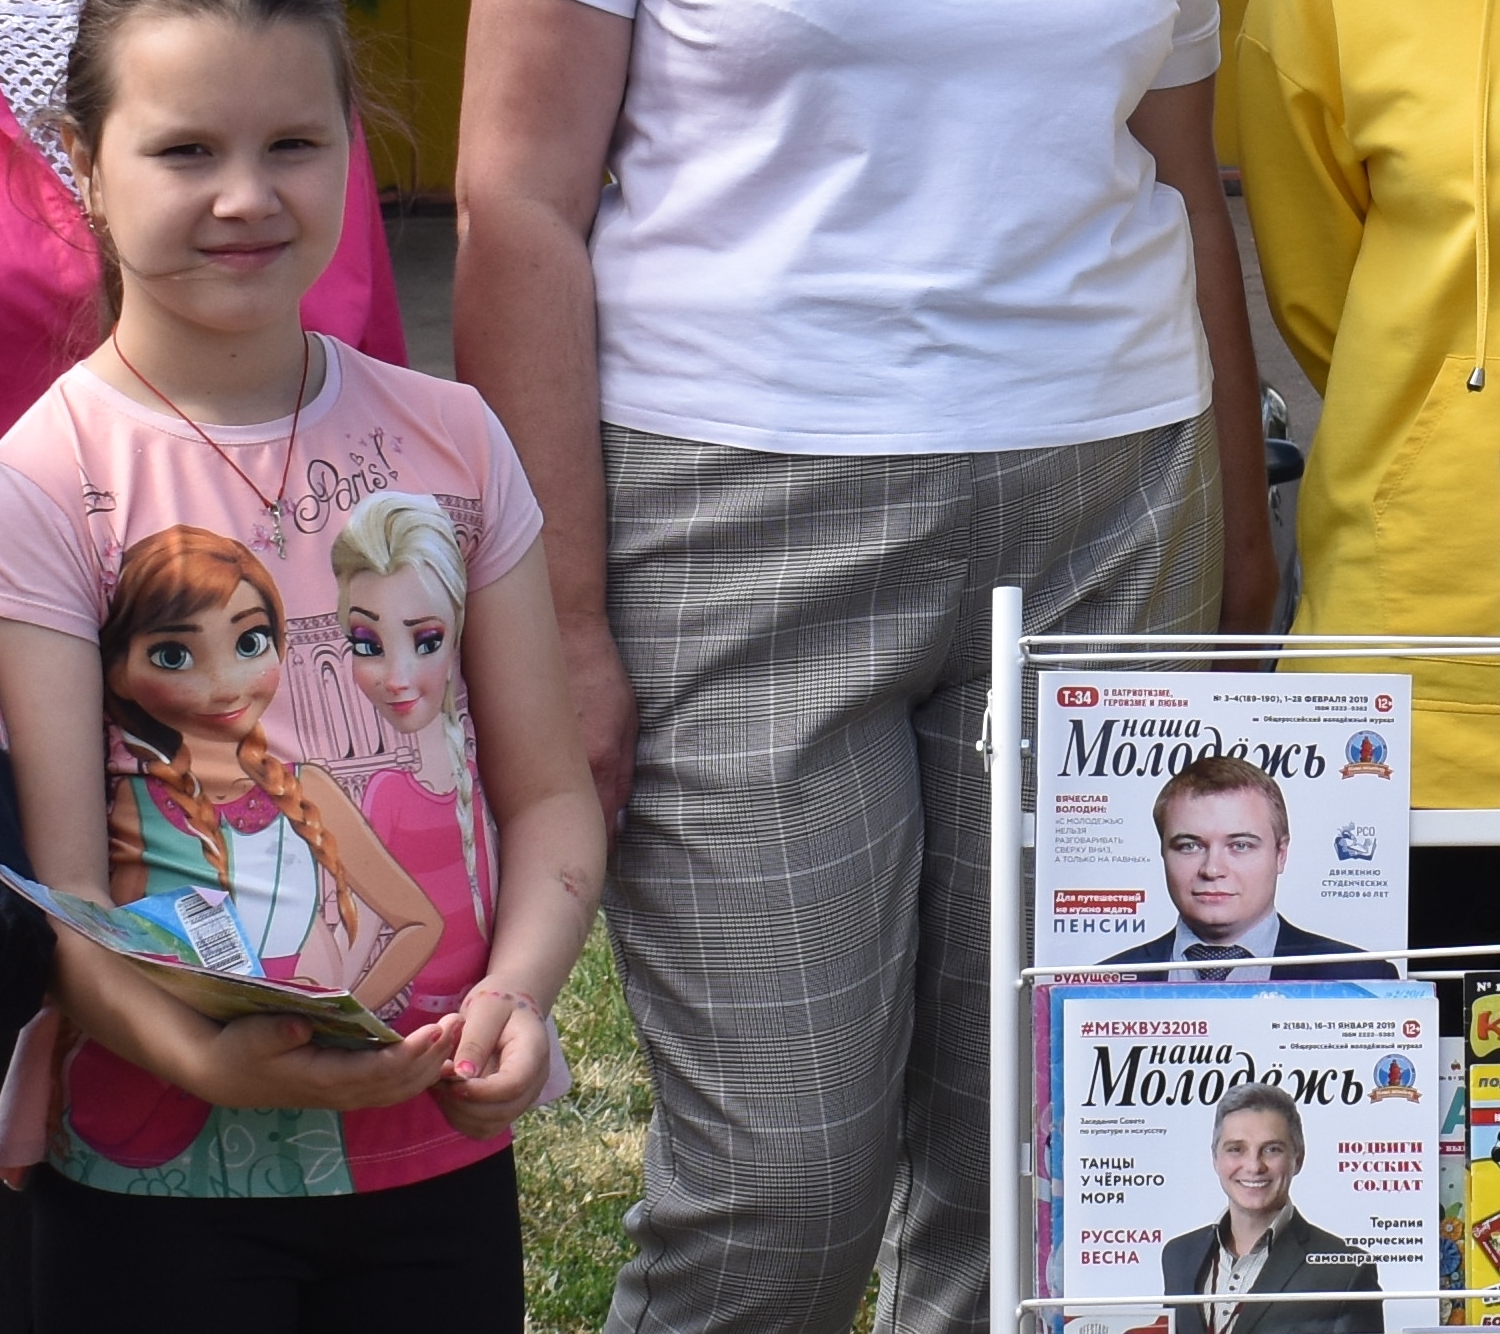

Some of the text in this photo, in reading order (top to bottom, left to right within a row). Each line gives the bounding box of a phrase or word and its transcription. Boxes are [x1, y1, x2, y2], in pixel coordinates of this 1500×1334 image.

[294, 433, 397, 534] Paris!
[1062, 690, 1092, 704] Т-34
[1121, 718, 1201, 738] наша
[1056, 795, 1108, 803] ВЯЧЕСЛАВ
[1056, 806, 1107, 814] ВОЛОДИН:
[1056, 892, 1142, 904] Для путешествий
[1053, 919, 1146, 934] ПЕНСИИ
[1081, 1020, 1208, 1037] #МЕЖВУЗ2018
[1149, 1043, 1233, 1065] наша
[1337, 1142, 1423, 1156] ПОДВИГИ
[1080, 1158, 1135, 1172] ТАНЦЫ
[1337, 1161, 1423, 1173] РУССКИХ
[1080, 1170, 1165, 1187] У ЧЁРНОГО
[1353, 1179, 1423, 1193] СОЛДАТ
[1081, 1191, 1125, 1204] МОРЯ
[1370, 1217, 1423, 1229] Терапия
[1081, 1229, 1162, 1244] РУССКАЯ
[1345, 1237, 1423, 1246] творческим
[1081, 1251, 1140, 1265] ВЕСНА
[1306, 1253, 1423, 1264] самовыражением
